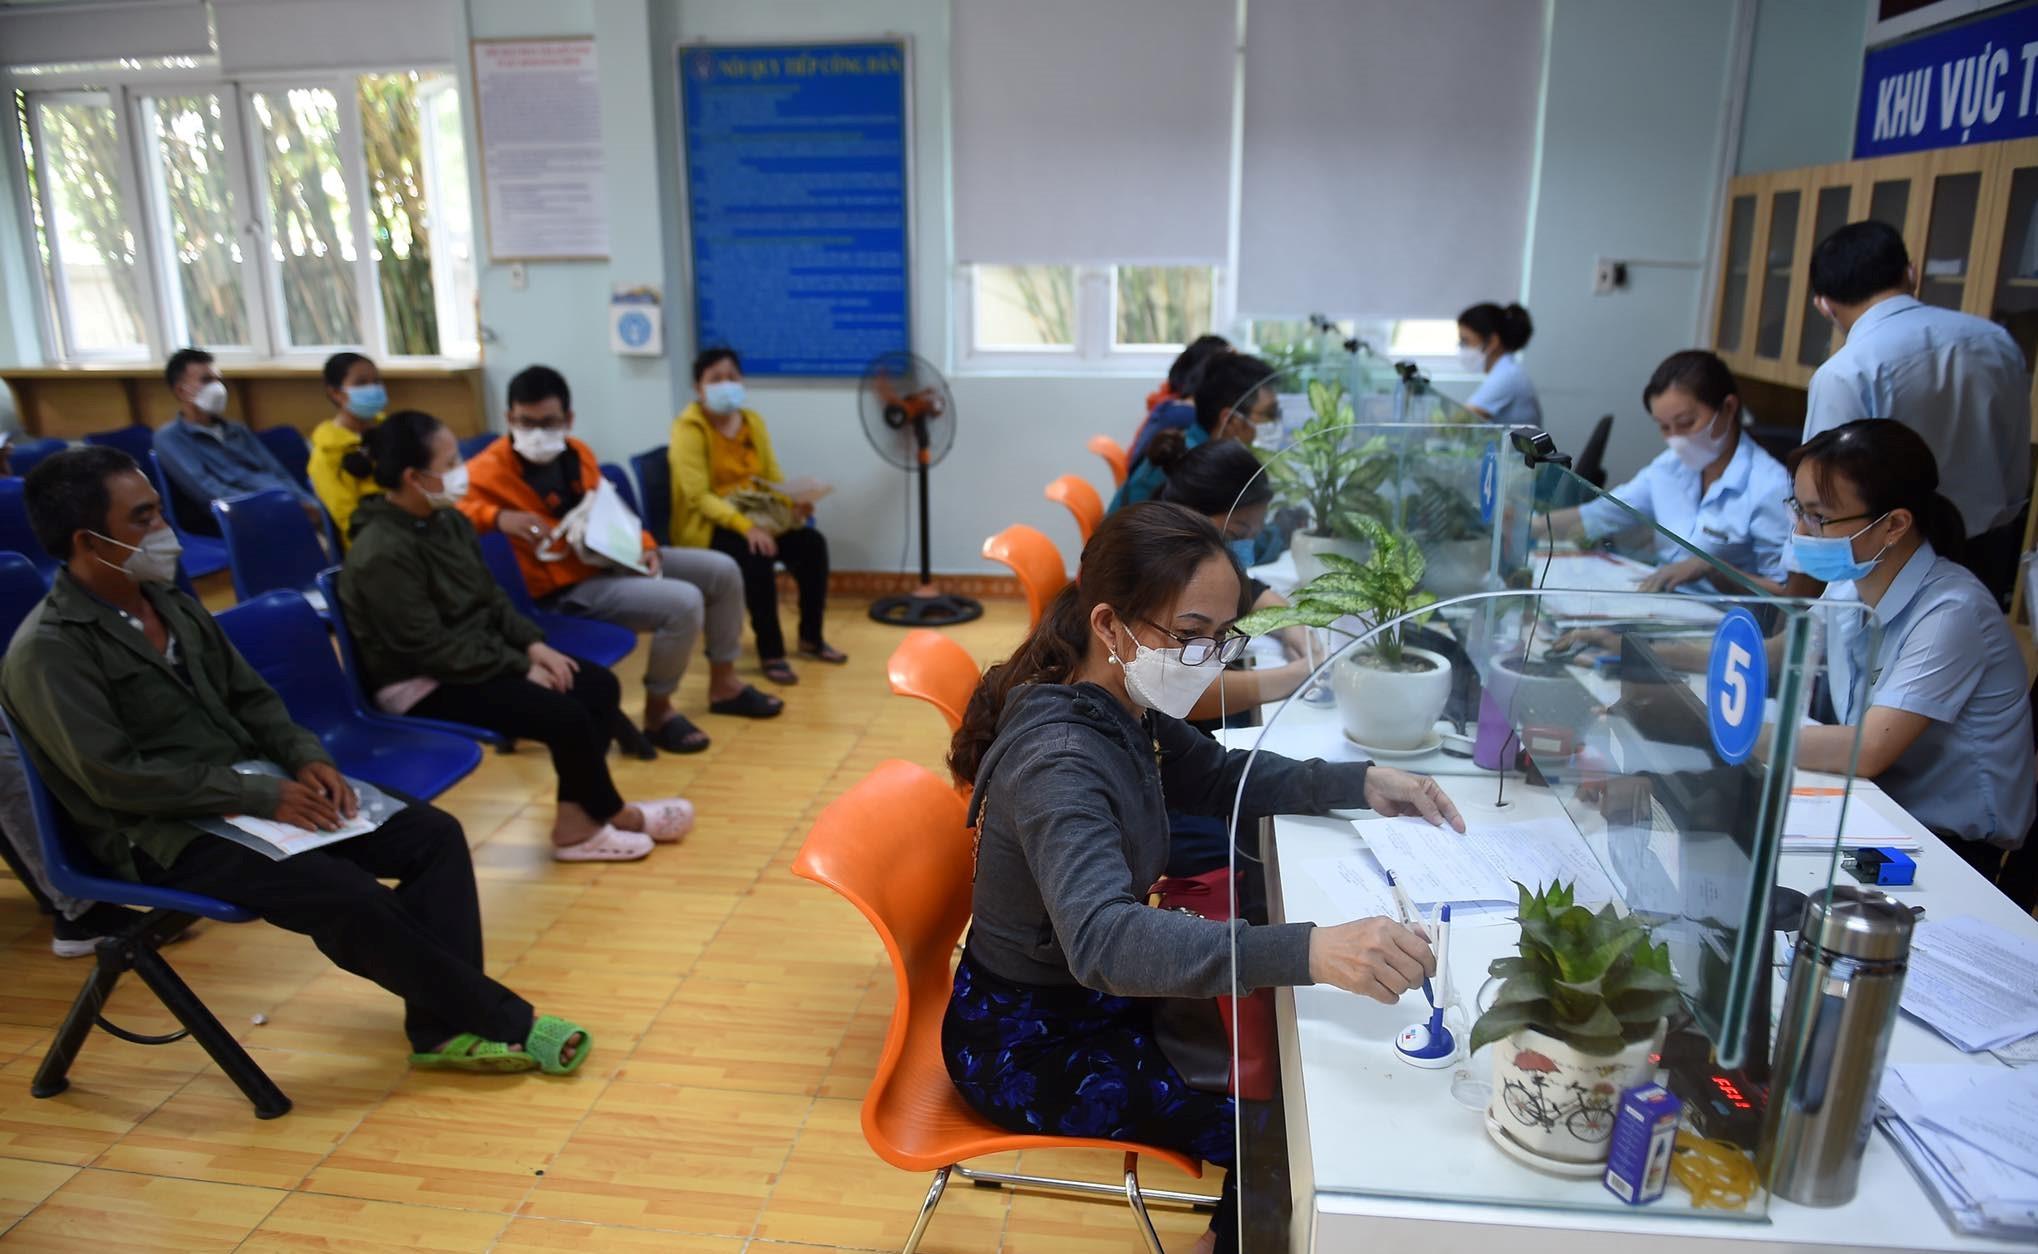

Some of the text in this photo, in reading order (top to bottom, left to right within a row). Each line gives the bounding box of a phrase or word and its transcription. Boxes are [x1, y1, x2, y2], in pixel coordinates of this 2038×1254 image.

[1872, 66, 1933, 142] KHU
[1940, 41, 2009, 144] VỰC
[1484, 462, 1493, 505] 4
[1720, 640, 1752, 727] 5
